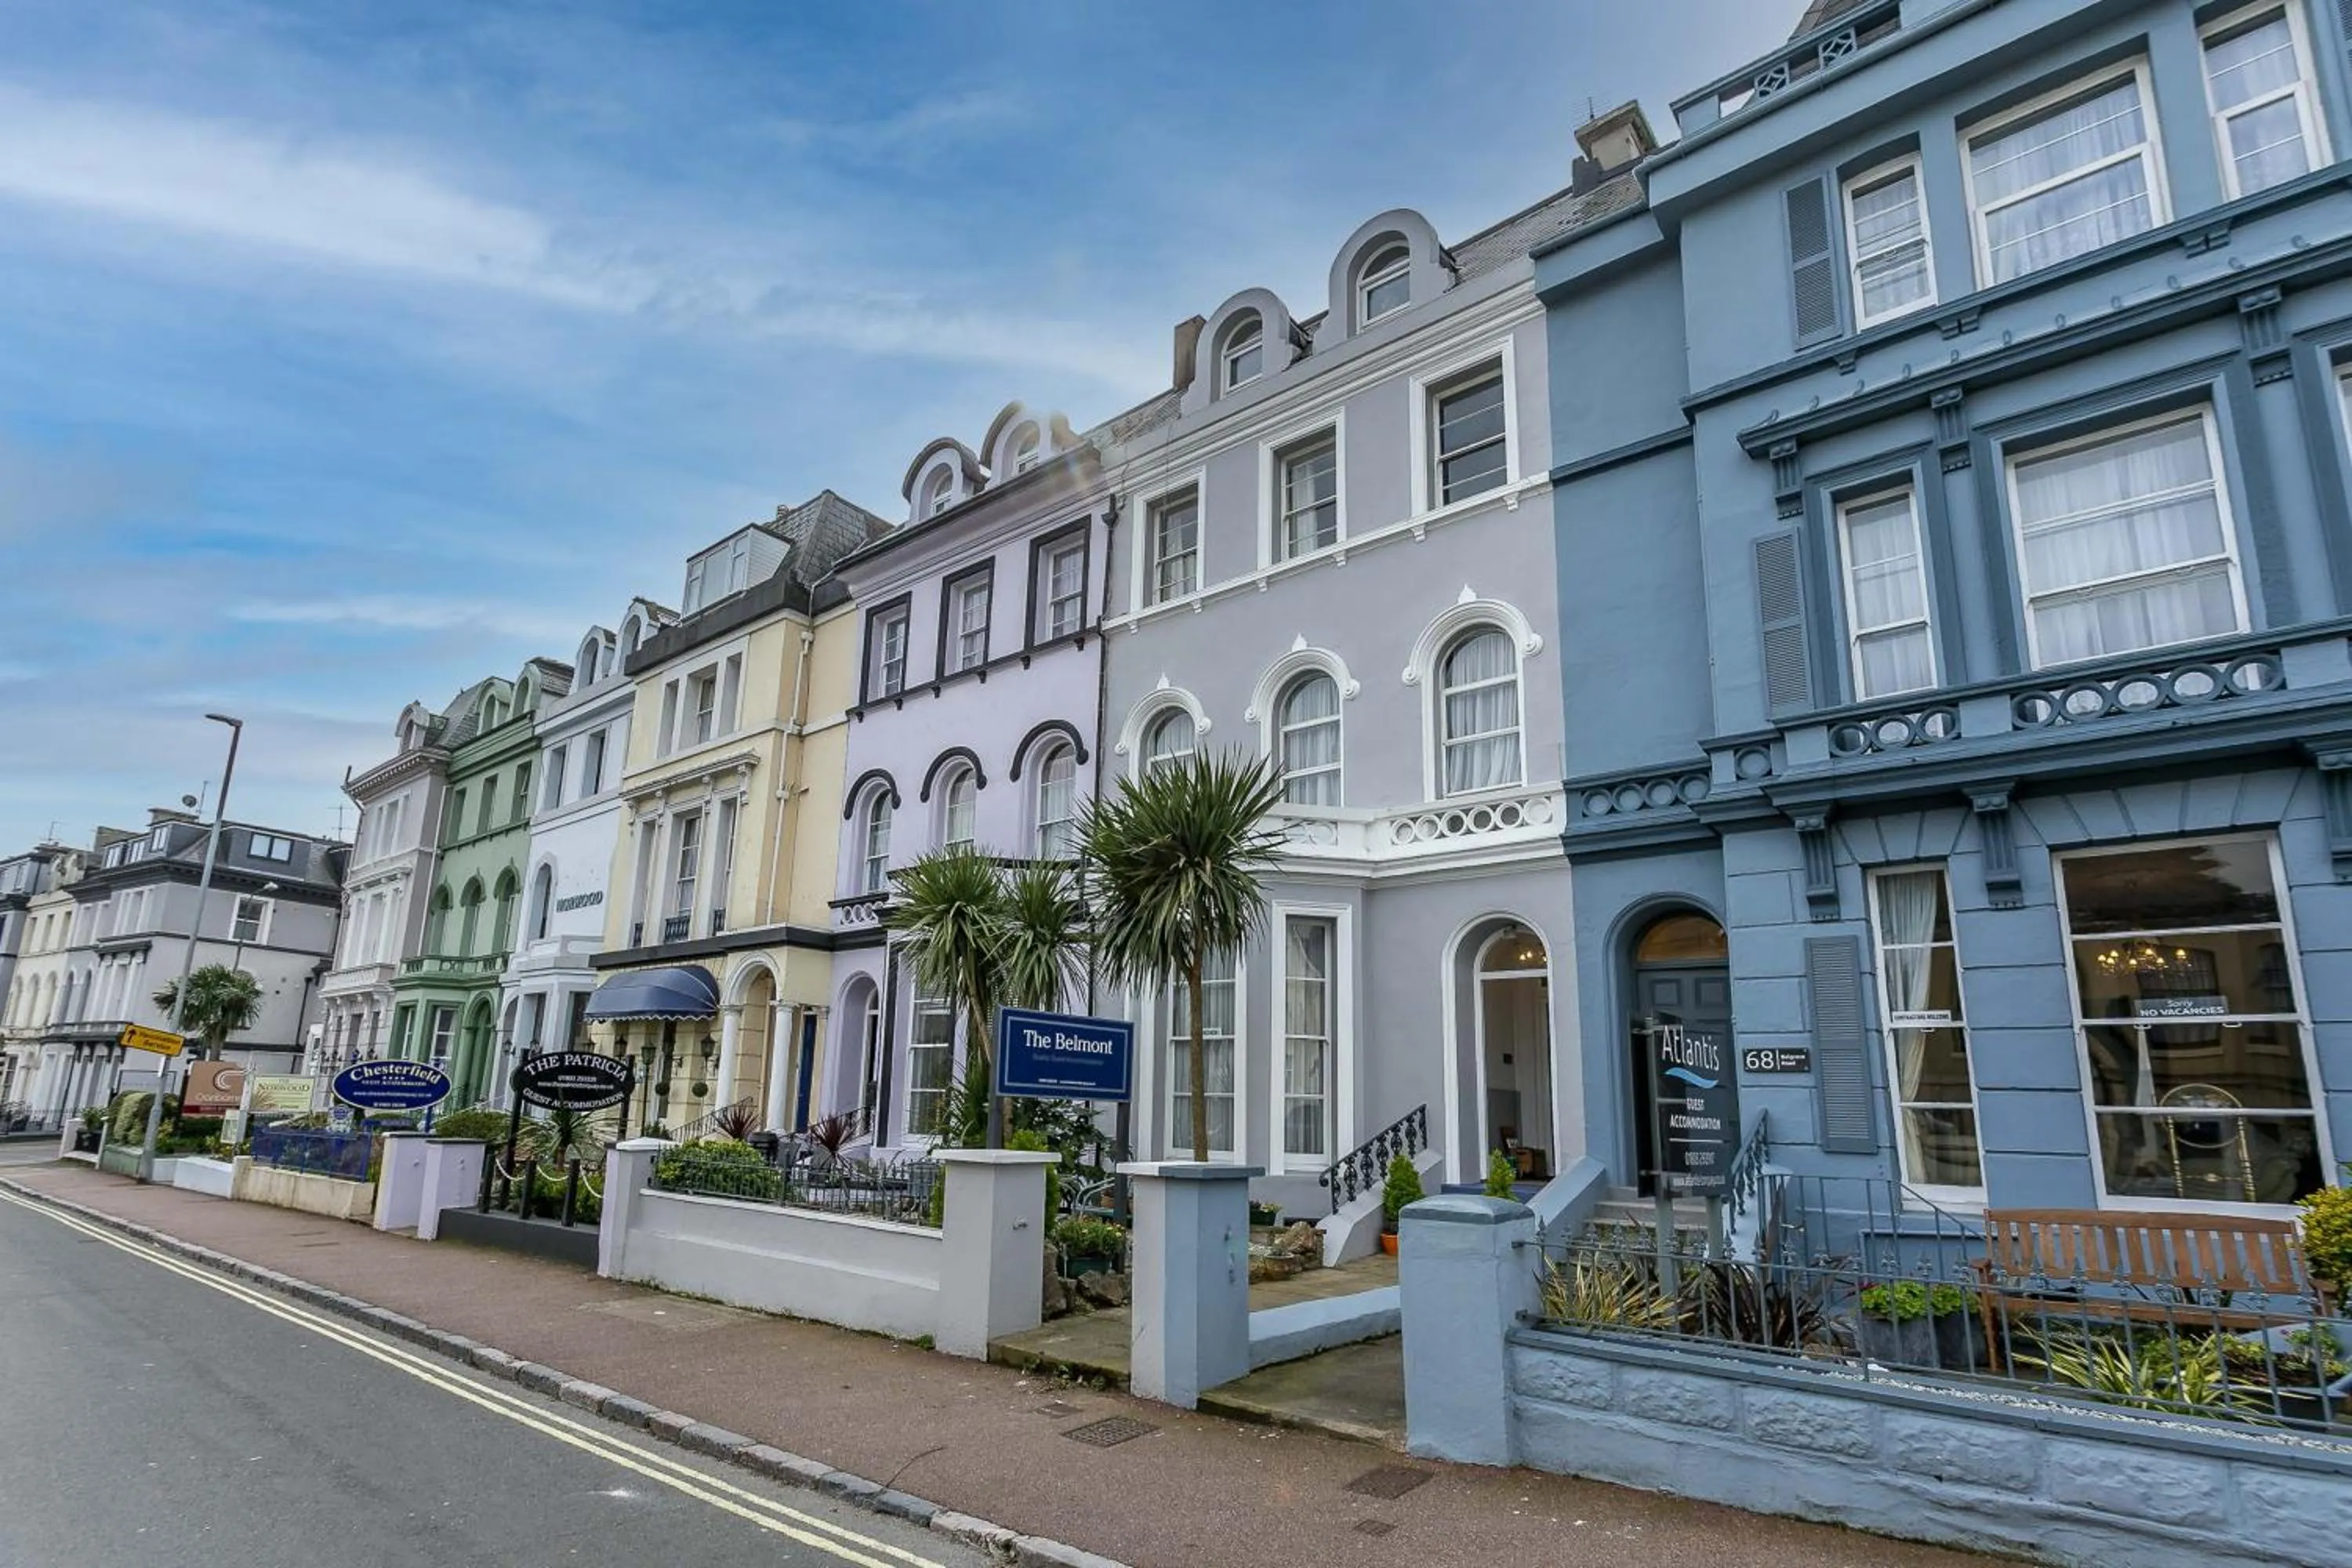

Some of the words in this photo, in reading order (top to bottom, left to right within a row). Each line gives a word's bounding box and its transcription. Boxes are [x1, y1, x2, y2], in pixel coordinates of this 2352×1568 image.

[2140, 1008, 2158, 1017] NO
[2159, 1006, 2225, 1016] VACANCIES
[1023, 1029, 1051, 1049] The
[1054, 1033, 1112, 1054] Belmont
[1662, 1025, 1719, 1071] Atlantis
[524, 1055, 560, 1076] THE
[564, 1053, 627, 1082] PATRICIA
[1746, 1050, 1774, 1069] 68
[350, 1064, 441, 1084] Chesterfield
[522, 1087, 553, 1105] GUEST
